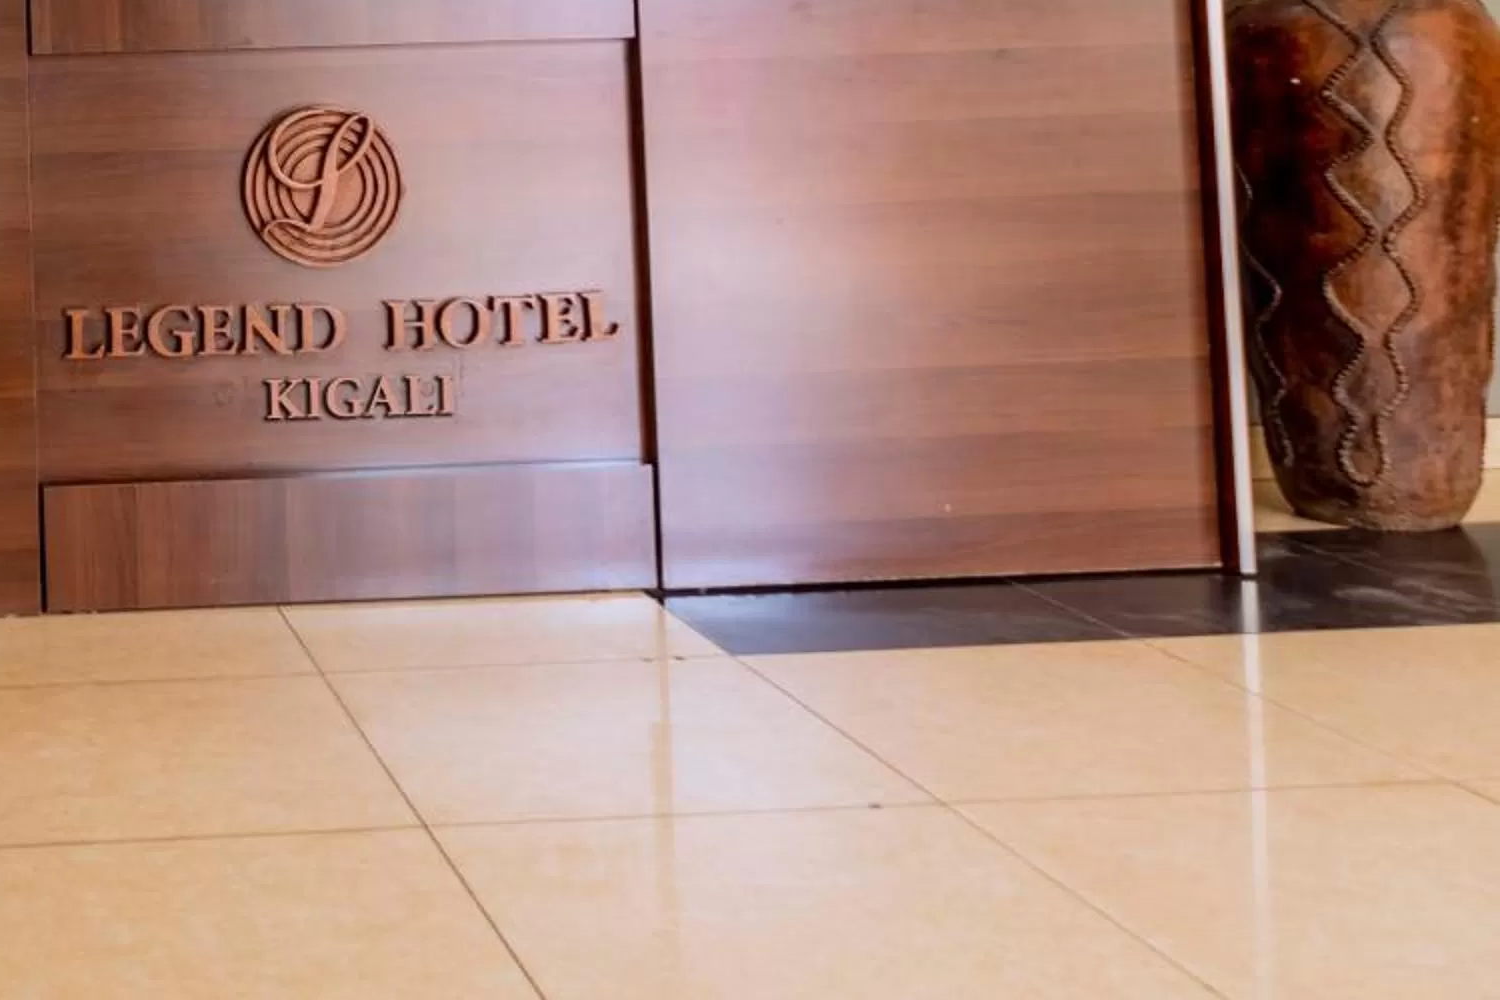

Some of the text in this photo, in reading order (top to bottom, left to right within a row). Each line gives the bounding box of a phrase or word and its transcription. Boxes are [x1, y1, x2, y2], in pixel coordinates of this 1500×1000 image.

[62, 289, 620, 361] LEGEND HOTEL
[263, 373, 456, 421] KIGALI
